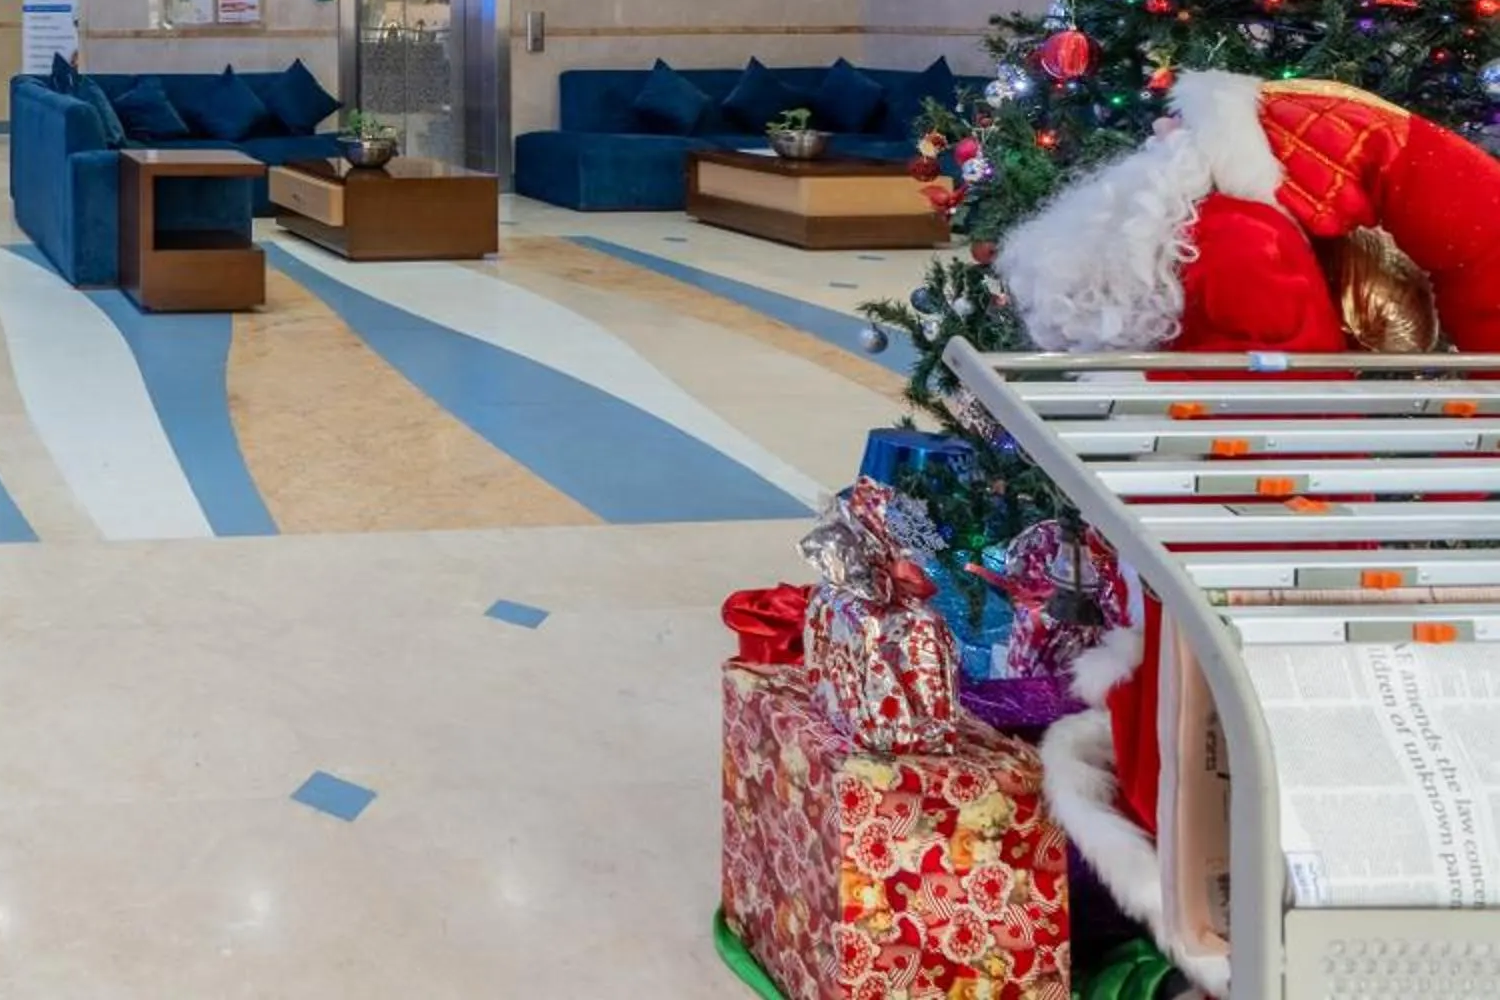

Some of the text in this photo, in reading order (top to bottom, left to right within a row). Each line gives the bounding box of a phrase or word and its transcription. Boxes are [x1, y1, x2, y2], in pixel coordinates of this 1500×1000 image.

[1389, 712, 1417, 739] of
[1403, 741, 1454, 846] unknown
[1399, 668, 1442, 752] amends
[1436, 757, 1461, 793] the
[1454, 798, 1475, 835] law
